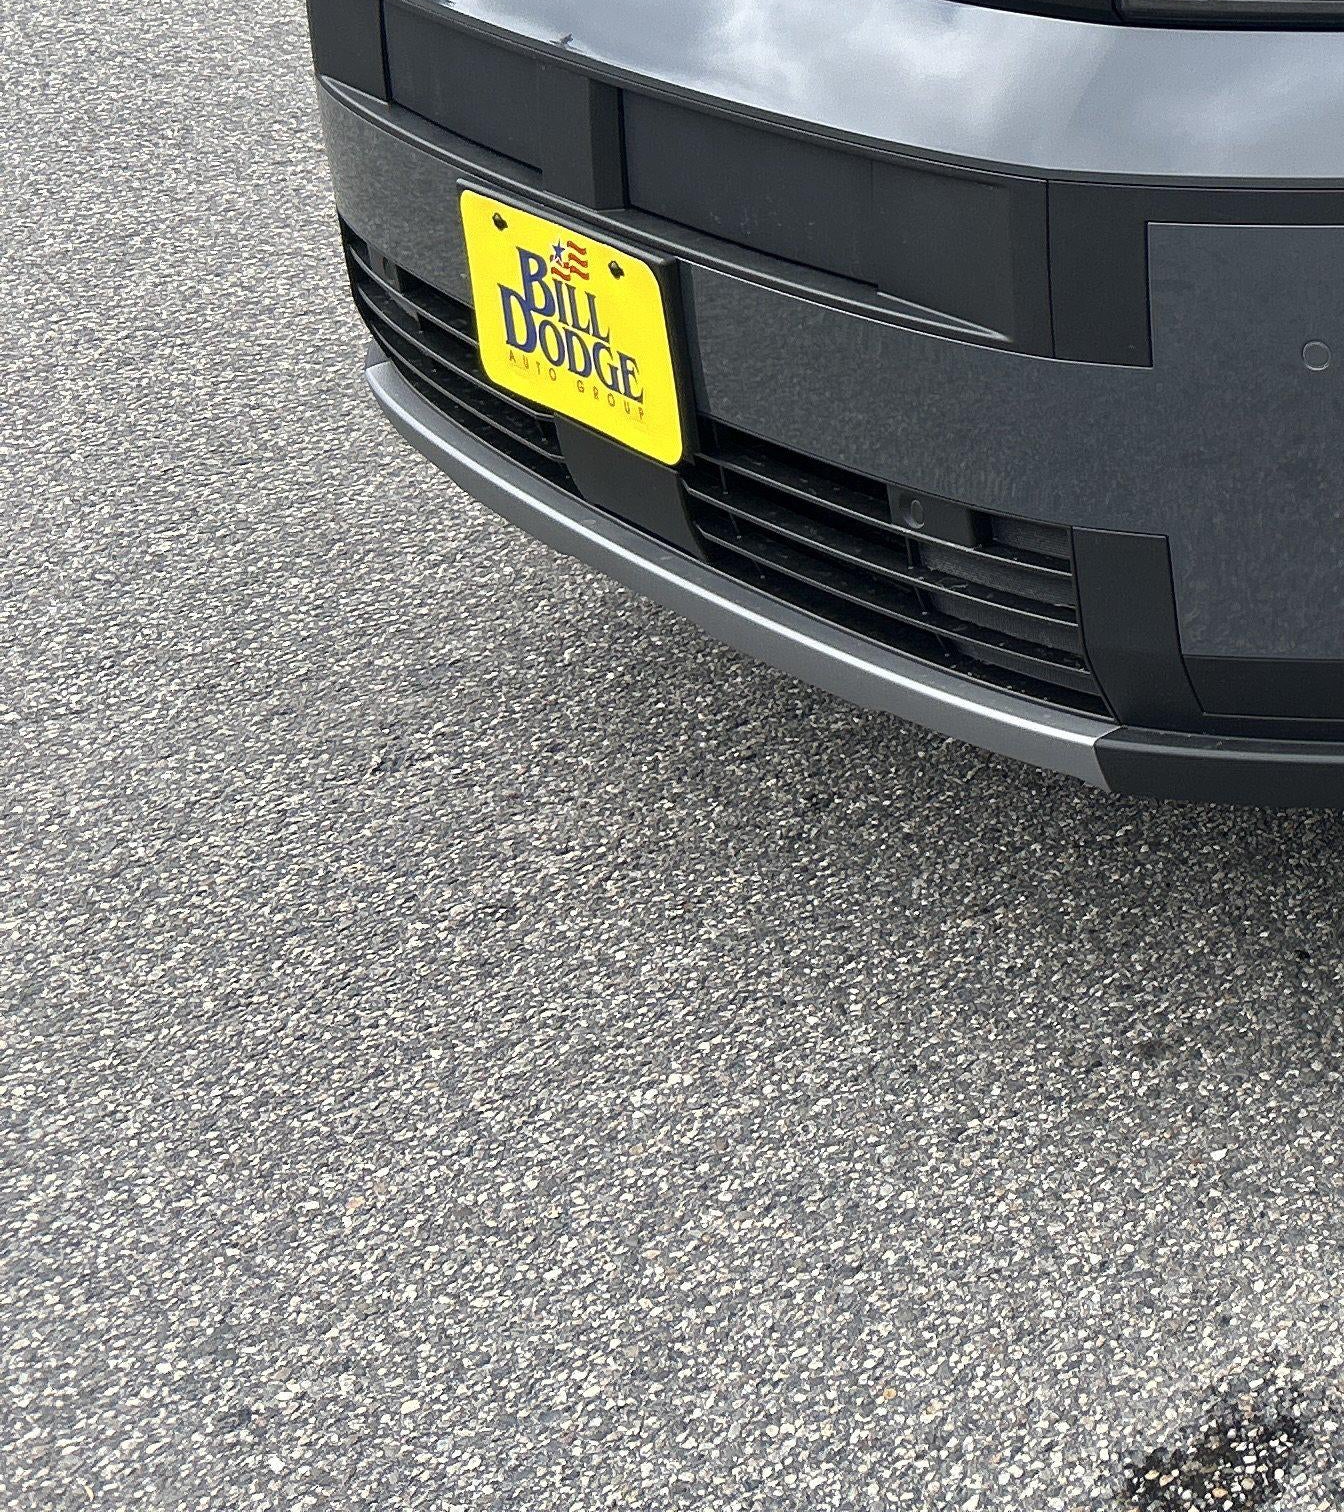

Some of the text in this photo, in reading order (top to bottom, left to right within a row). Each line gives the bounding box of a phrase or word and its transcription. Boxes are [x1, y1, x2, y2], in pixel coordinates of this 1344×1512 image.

[517, 246, 611, 343] BILL
[497, 283, 644, 404] DODGE
[509, 350, 645, 420] AUTO GROUP
